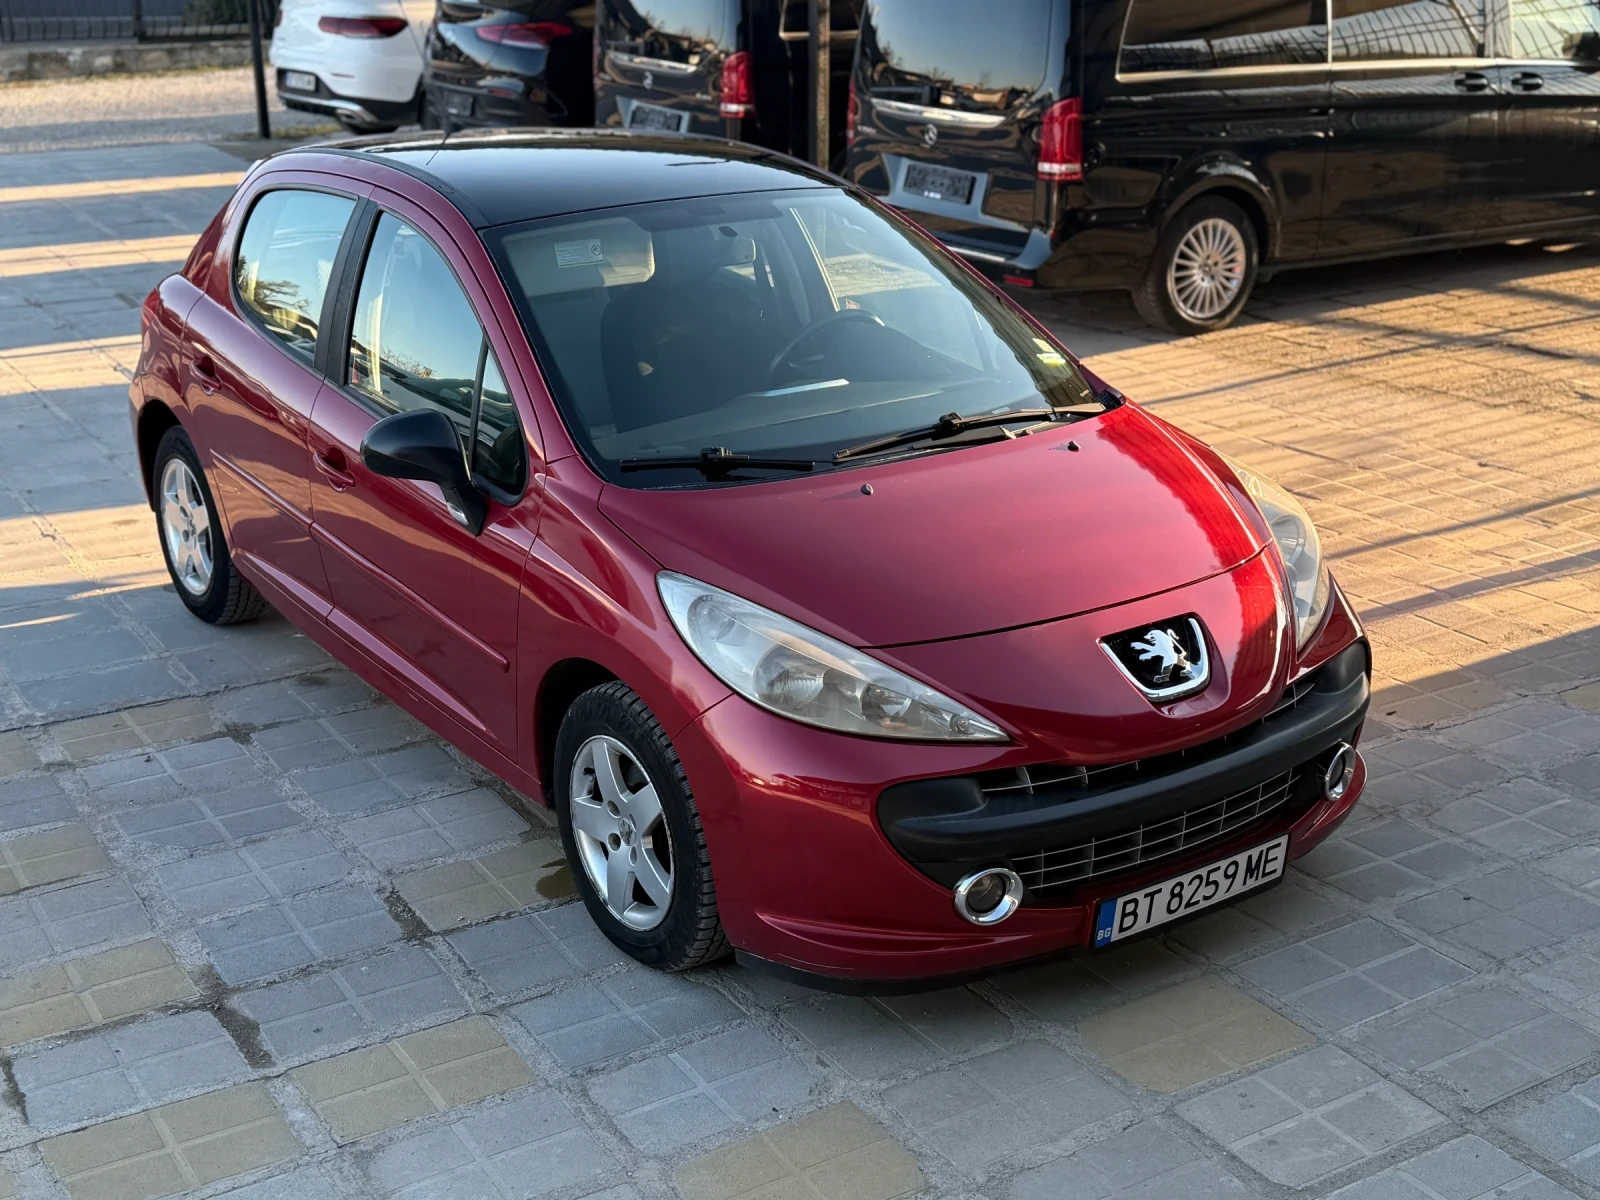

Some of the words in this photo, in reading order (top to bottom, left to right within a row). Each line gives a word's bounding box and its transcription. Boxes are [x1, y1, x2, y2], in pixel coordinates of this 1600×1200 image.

[1117, 888, 1163, 934] BT
[1166, 860, 1239, 915] 8259
[1243, 842, 1282, 886] ME
[1097, 927, 1111, 941] BG
